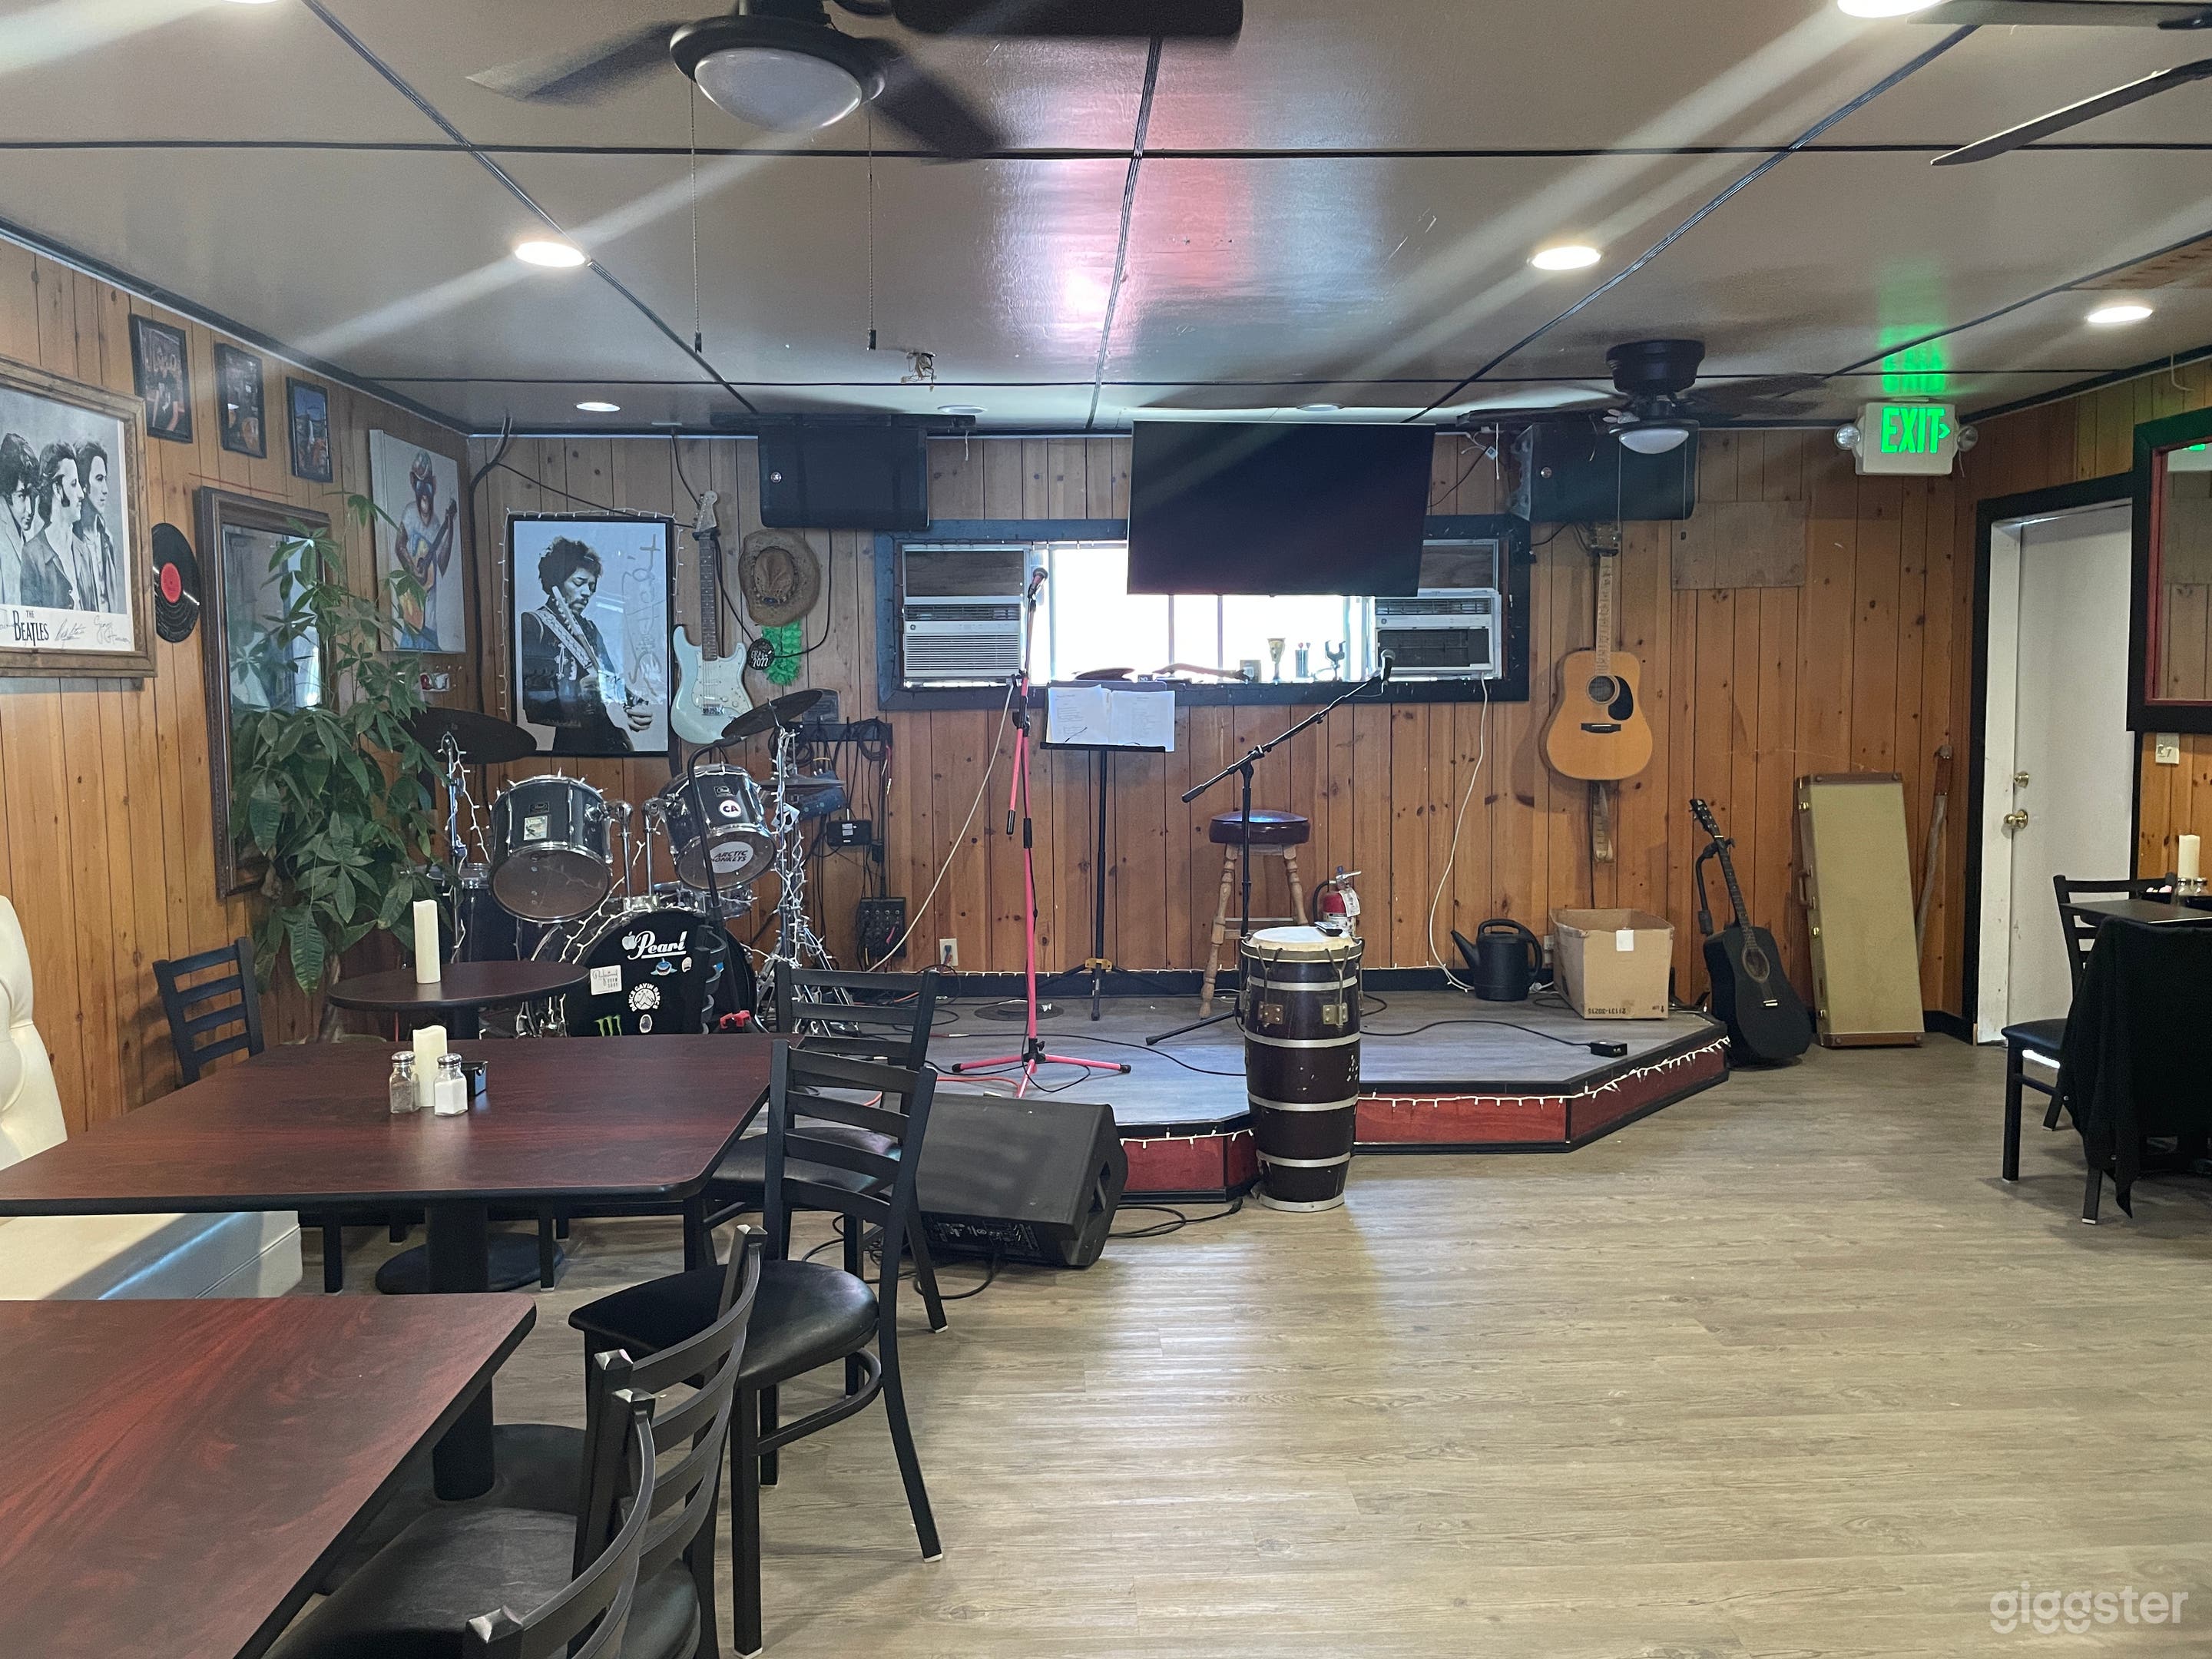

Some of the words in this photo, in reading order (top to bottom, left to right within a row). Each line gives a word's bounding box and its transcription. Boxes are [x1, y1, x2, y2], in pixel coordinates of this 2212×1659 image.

[1880, 406, 1945, 453] EXIT
[26, 610, 35, 618] THE
[12, 610, 49, 647] BEATLES
[714, 849, 748, 858] ARCTIC
[628, 930, 687, 960] Pearl
[634, 983, 654, 992] GAVIN
